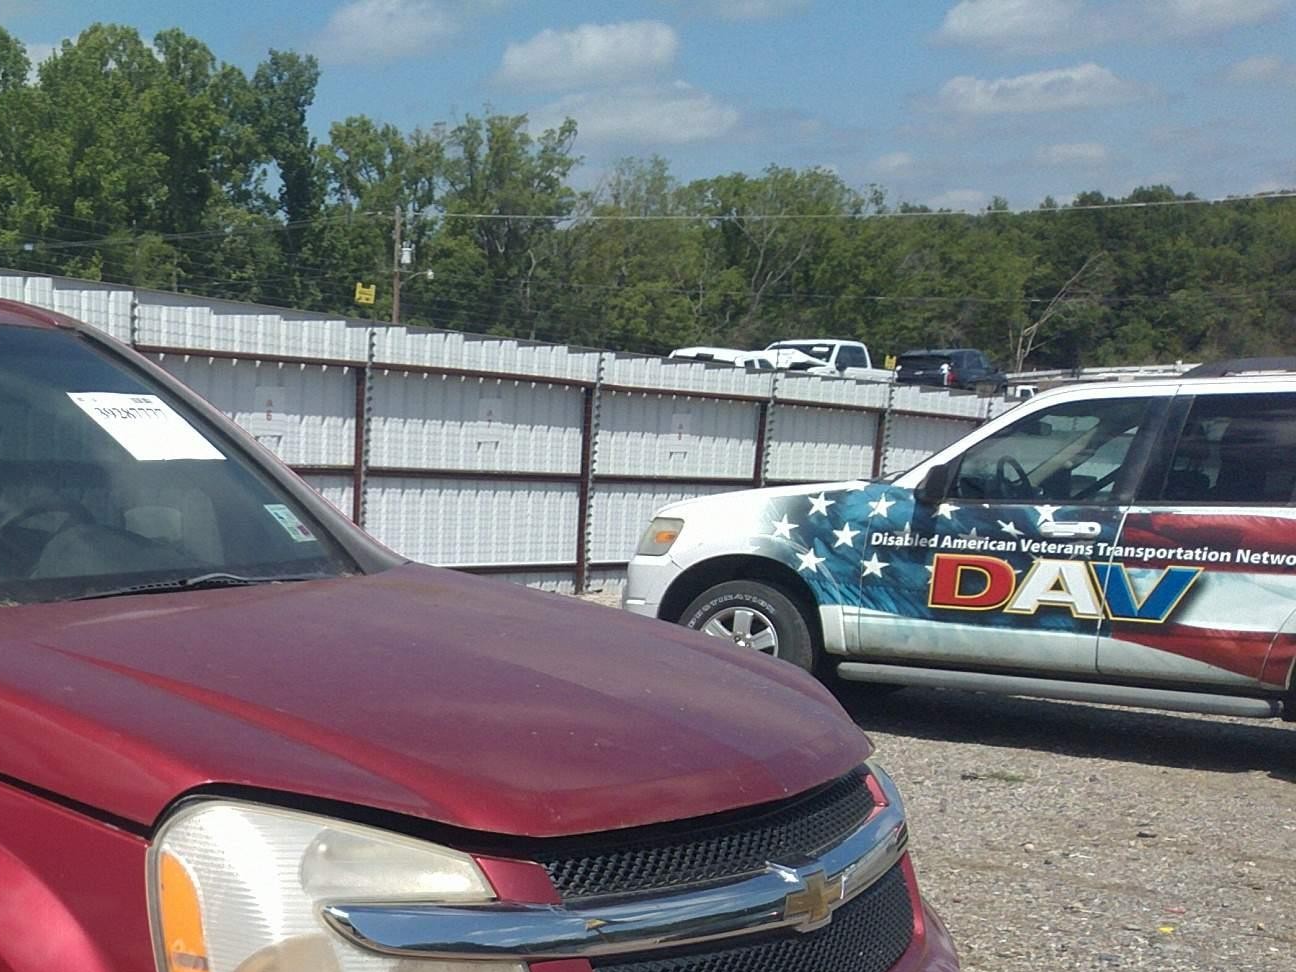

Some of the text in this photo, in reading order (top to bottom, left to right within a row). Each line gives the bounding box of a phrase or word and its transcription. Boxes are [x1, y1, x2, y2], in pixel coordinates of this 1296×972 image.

[871, 532, 938, 548] Disabled
[941, 535, 1017, 552] American
[1020, 538, 1093, 556] Veterans
[1097, 542, 1231, 564] Transportation
[928, 553, 1204, 624] DAV
